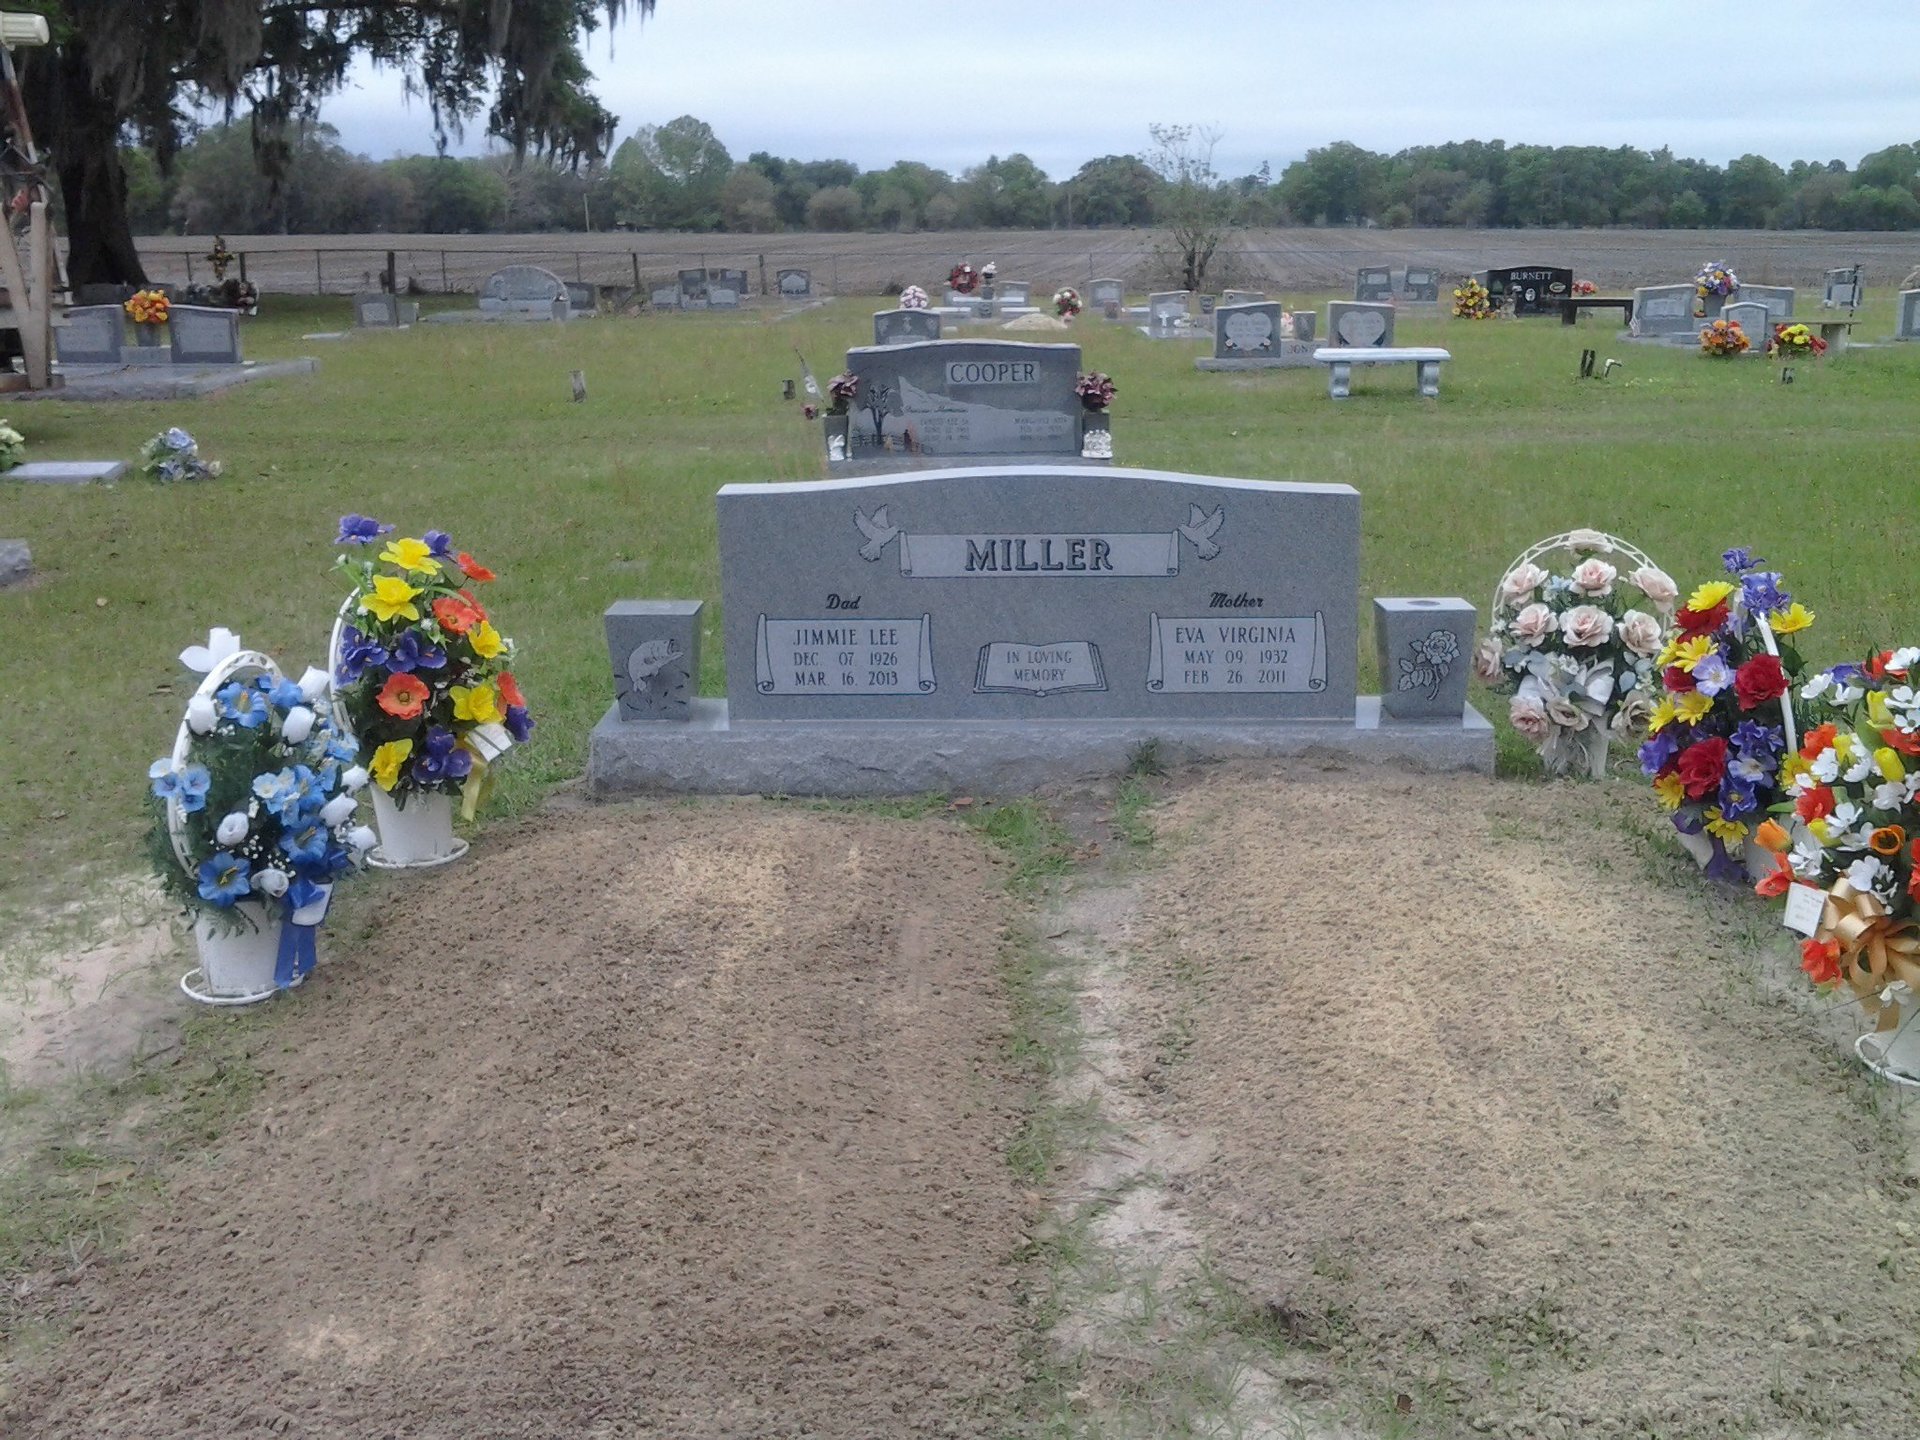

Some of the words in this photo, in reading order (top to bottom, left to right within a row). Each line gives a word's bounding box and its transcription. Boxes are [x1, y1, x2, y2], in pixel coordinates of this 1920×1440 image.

[1510, 271, 1552, 280] BURNETT
[950, 363, 1035, 383] COOPER
[965, 539, 1114, 571] MILLER
[825, 593, 862, 610] Dad
[1208, 592, 1264, 609] Mother
[793, 629, 858, 646] JIMMIE
[870, 629, 898, 646] LEE
[1175, 627, 1205, 643] EVA
[1219, 627, 1296, 643] VIRGINIA
[870, 651, 898, 666] 1926
[1007, 651, 1020, 664] IN
[1028, 650, 1072, 664] LOVING
[1184, 650, 1214, 664] MAY
[1260, 650, 1288, 664] 1932
[868, 671, 898, 686] 2013
[1014, 669, 1067, 682] MEMORY
[1258, 669, 1286, 684] 2011
